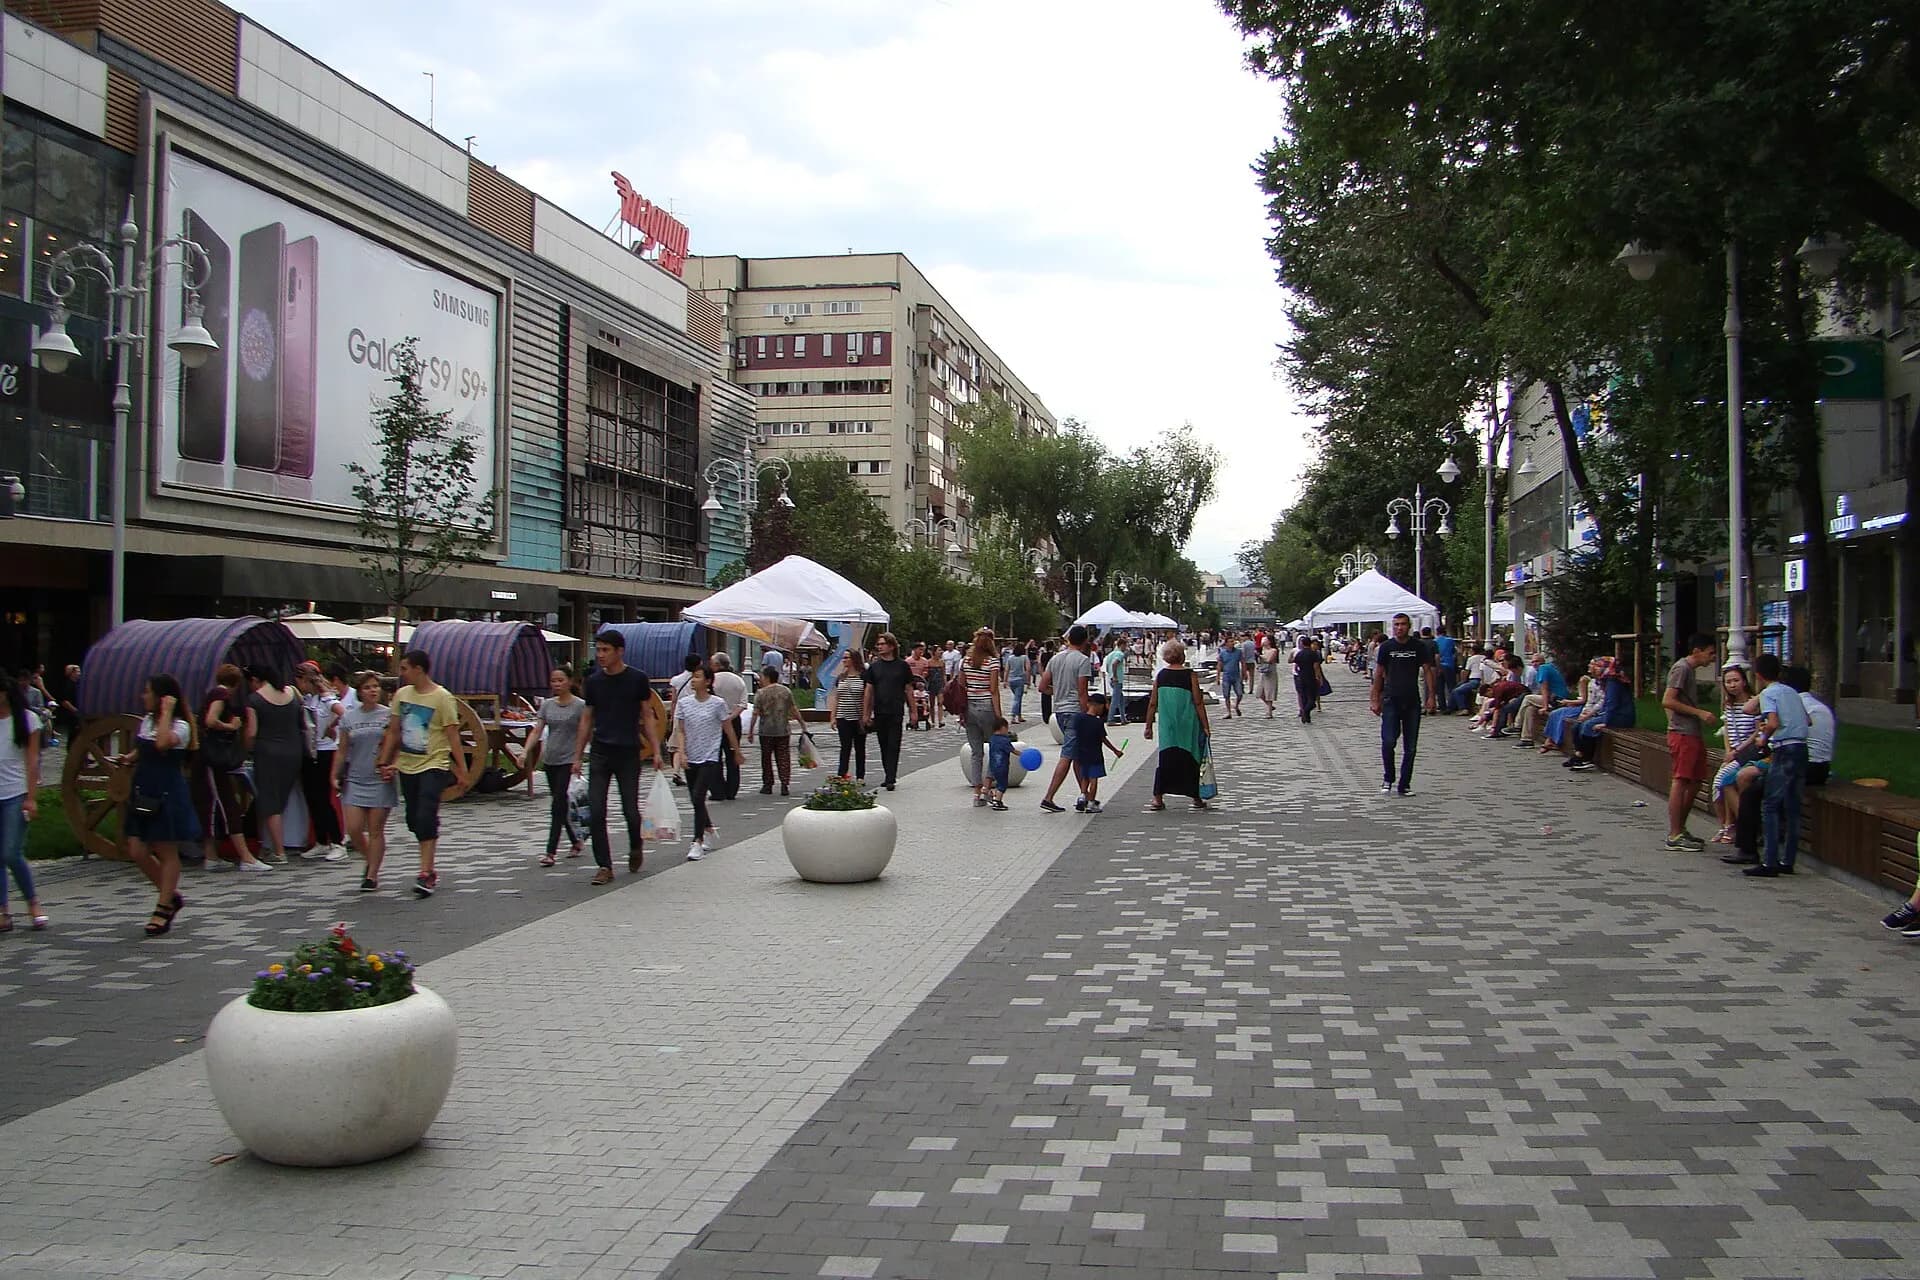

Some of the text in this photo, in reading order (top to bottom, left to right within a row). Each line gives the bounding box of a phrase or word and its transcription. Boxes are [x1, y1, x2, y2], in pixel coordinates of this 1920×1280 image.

[433, 288, 489, 328] SAMSUNG
[348, 328, 488, 401] Galay S9 S9+
